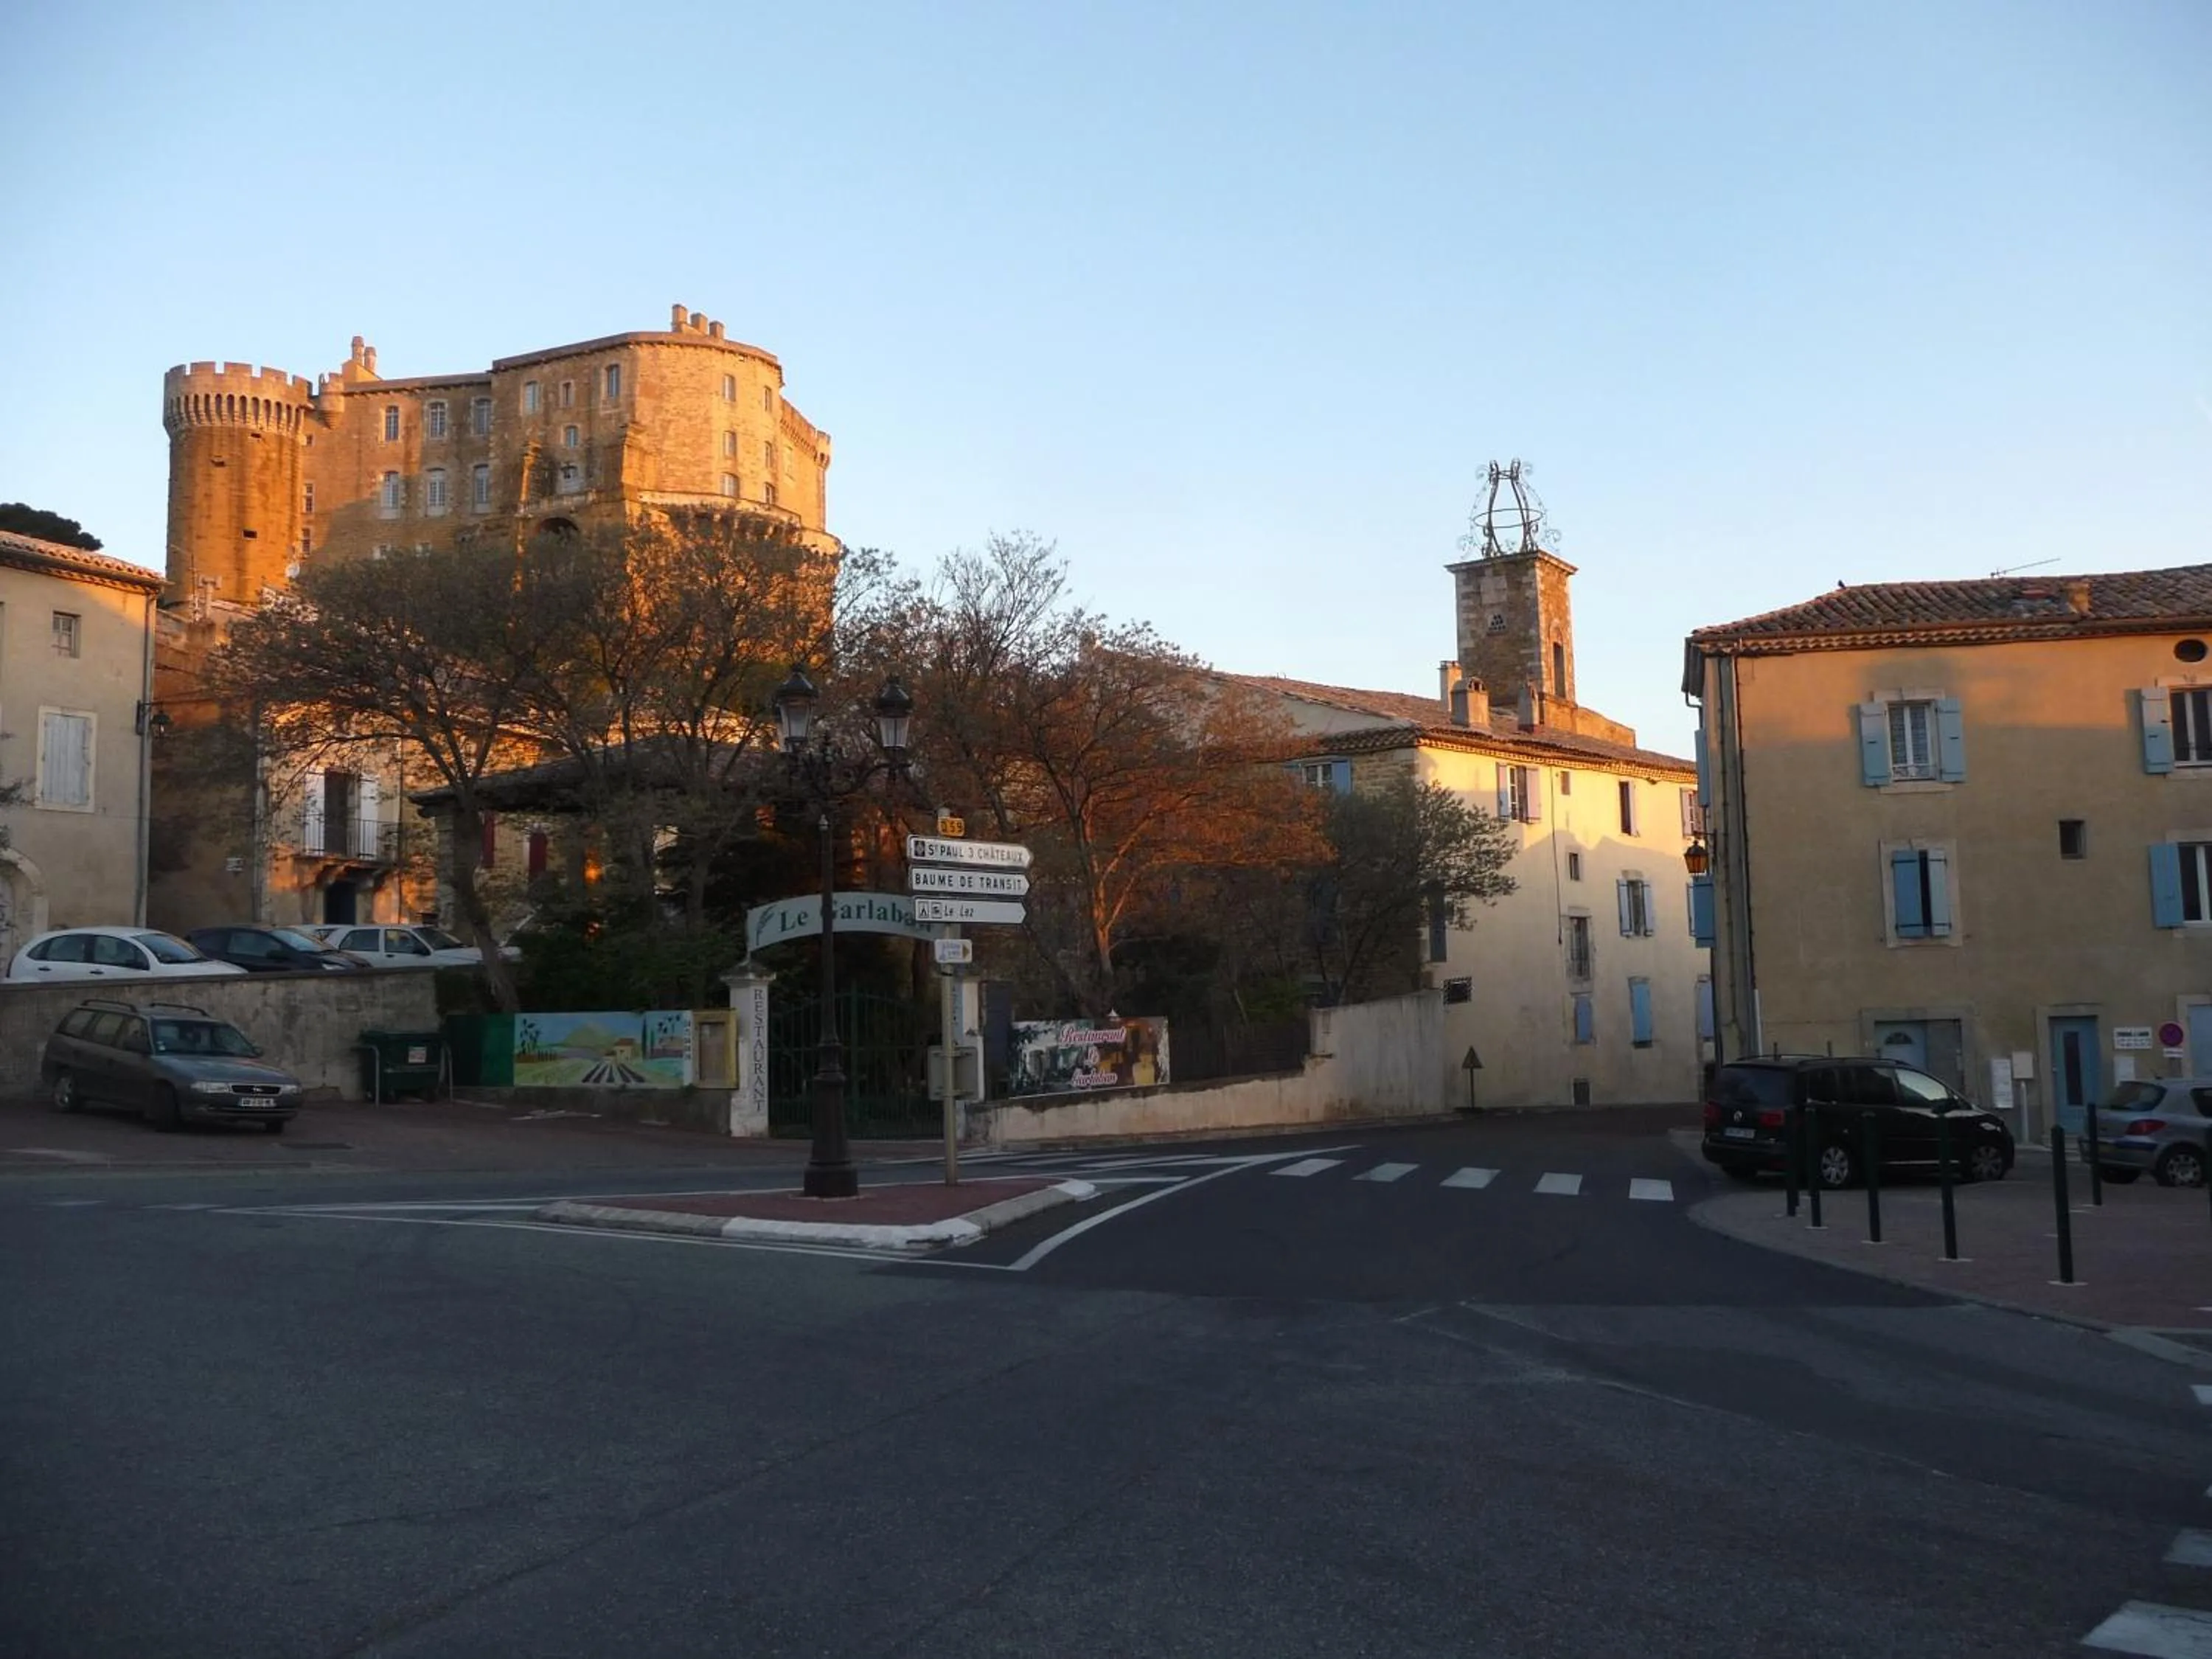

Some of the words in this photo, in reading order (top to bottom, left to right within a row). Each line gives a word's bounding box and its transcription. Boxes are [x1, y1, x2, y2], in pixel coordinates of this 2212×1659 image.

[940, 845, 964, 858] PAUL
[968, 846, 975, 858] 3
[977, 846, 1023, 862] CHÂTEAUX
[914, 873, 953, 887] BAUME
[959, 875, 973, 888] DE
[978, 877, 1023, 891] TRANSIT
[944, 905, 953, 917] Le
[780, 910, 809, 933] Le
[754, 989, 765, 1112] RESTAURANT
